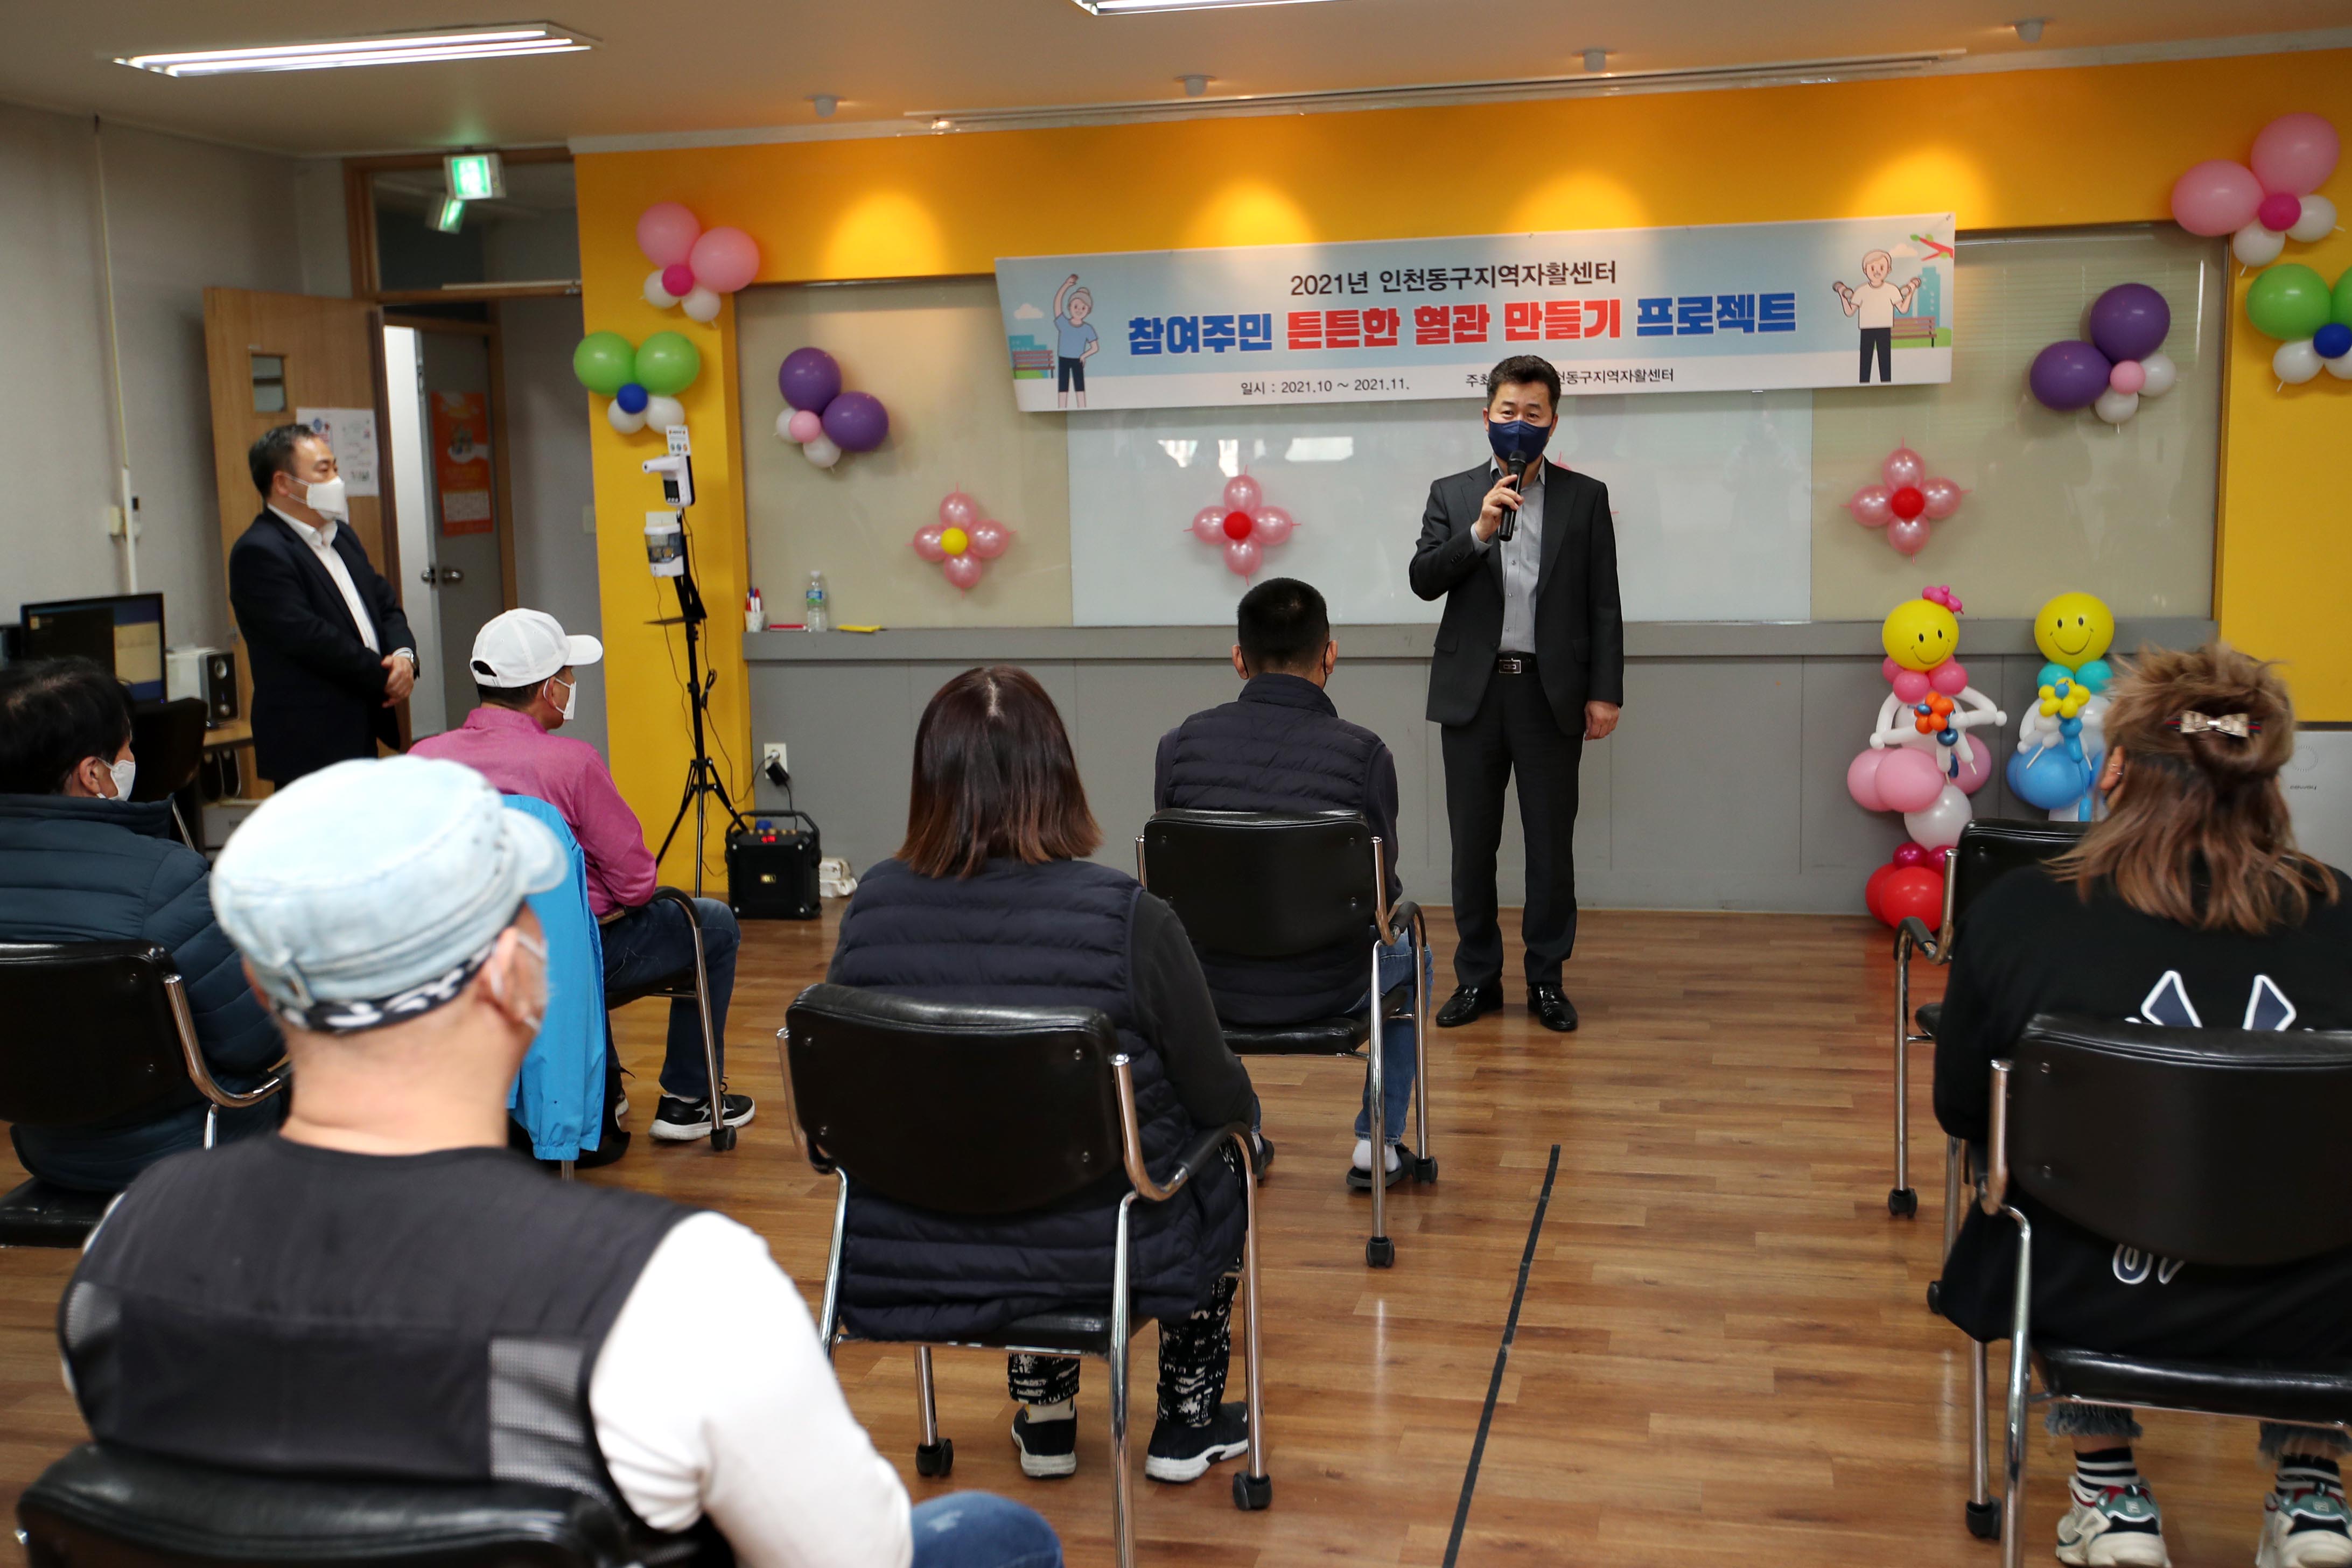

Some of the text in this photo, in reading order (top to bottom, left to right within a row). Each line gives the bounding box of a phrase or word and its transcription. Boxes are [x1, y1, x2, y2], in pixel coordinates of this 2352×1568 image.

[1291, 260, 1616, 296] 2021년 인천동구지역자활센터
[1129, 292, 1796, 356] 참여주민 튼튼한 혈관 만들기 프로젝트
[1240, 381, 1265, 395] 일시
[1281, 380, 1332, 394] 2021.10
